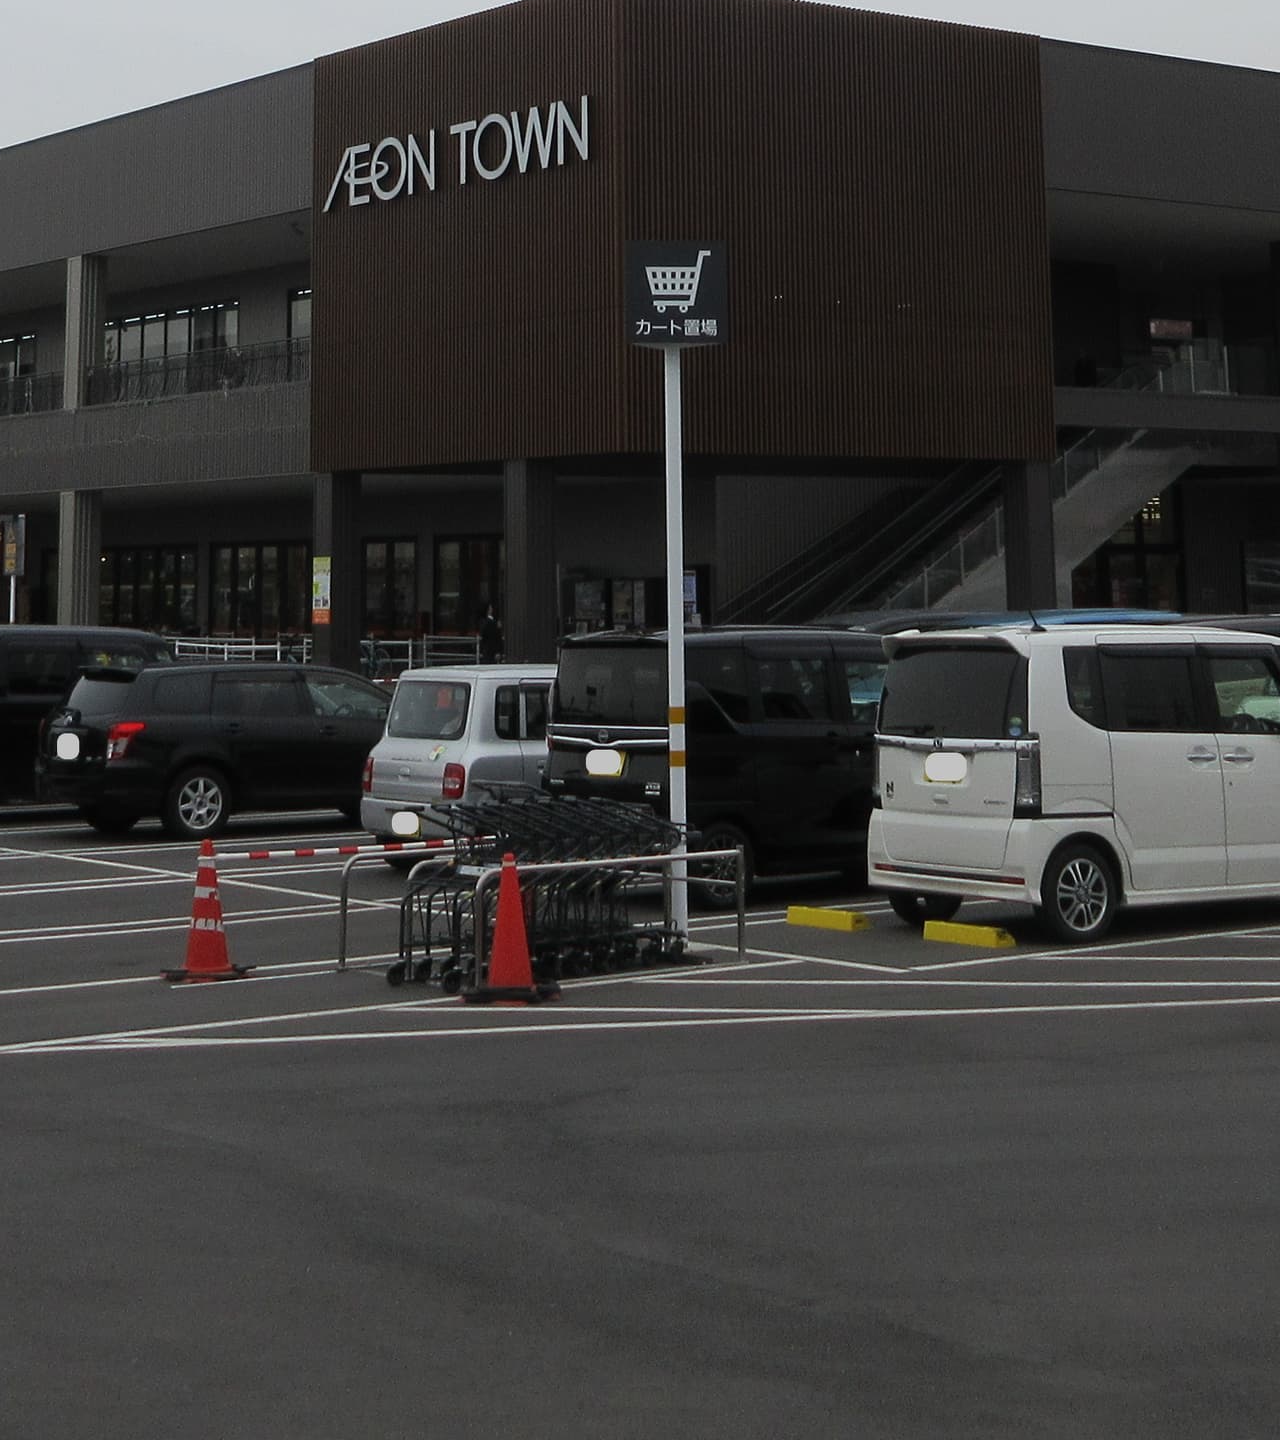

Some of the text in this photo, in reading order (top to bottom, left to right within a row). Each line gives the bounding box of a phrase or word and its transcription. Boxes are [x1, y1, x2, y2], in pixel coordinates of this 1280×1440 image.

[450, 94, 589, 185] TOWN
[635, 318, 718, 336] カート置場
